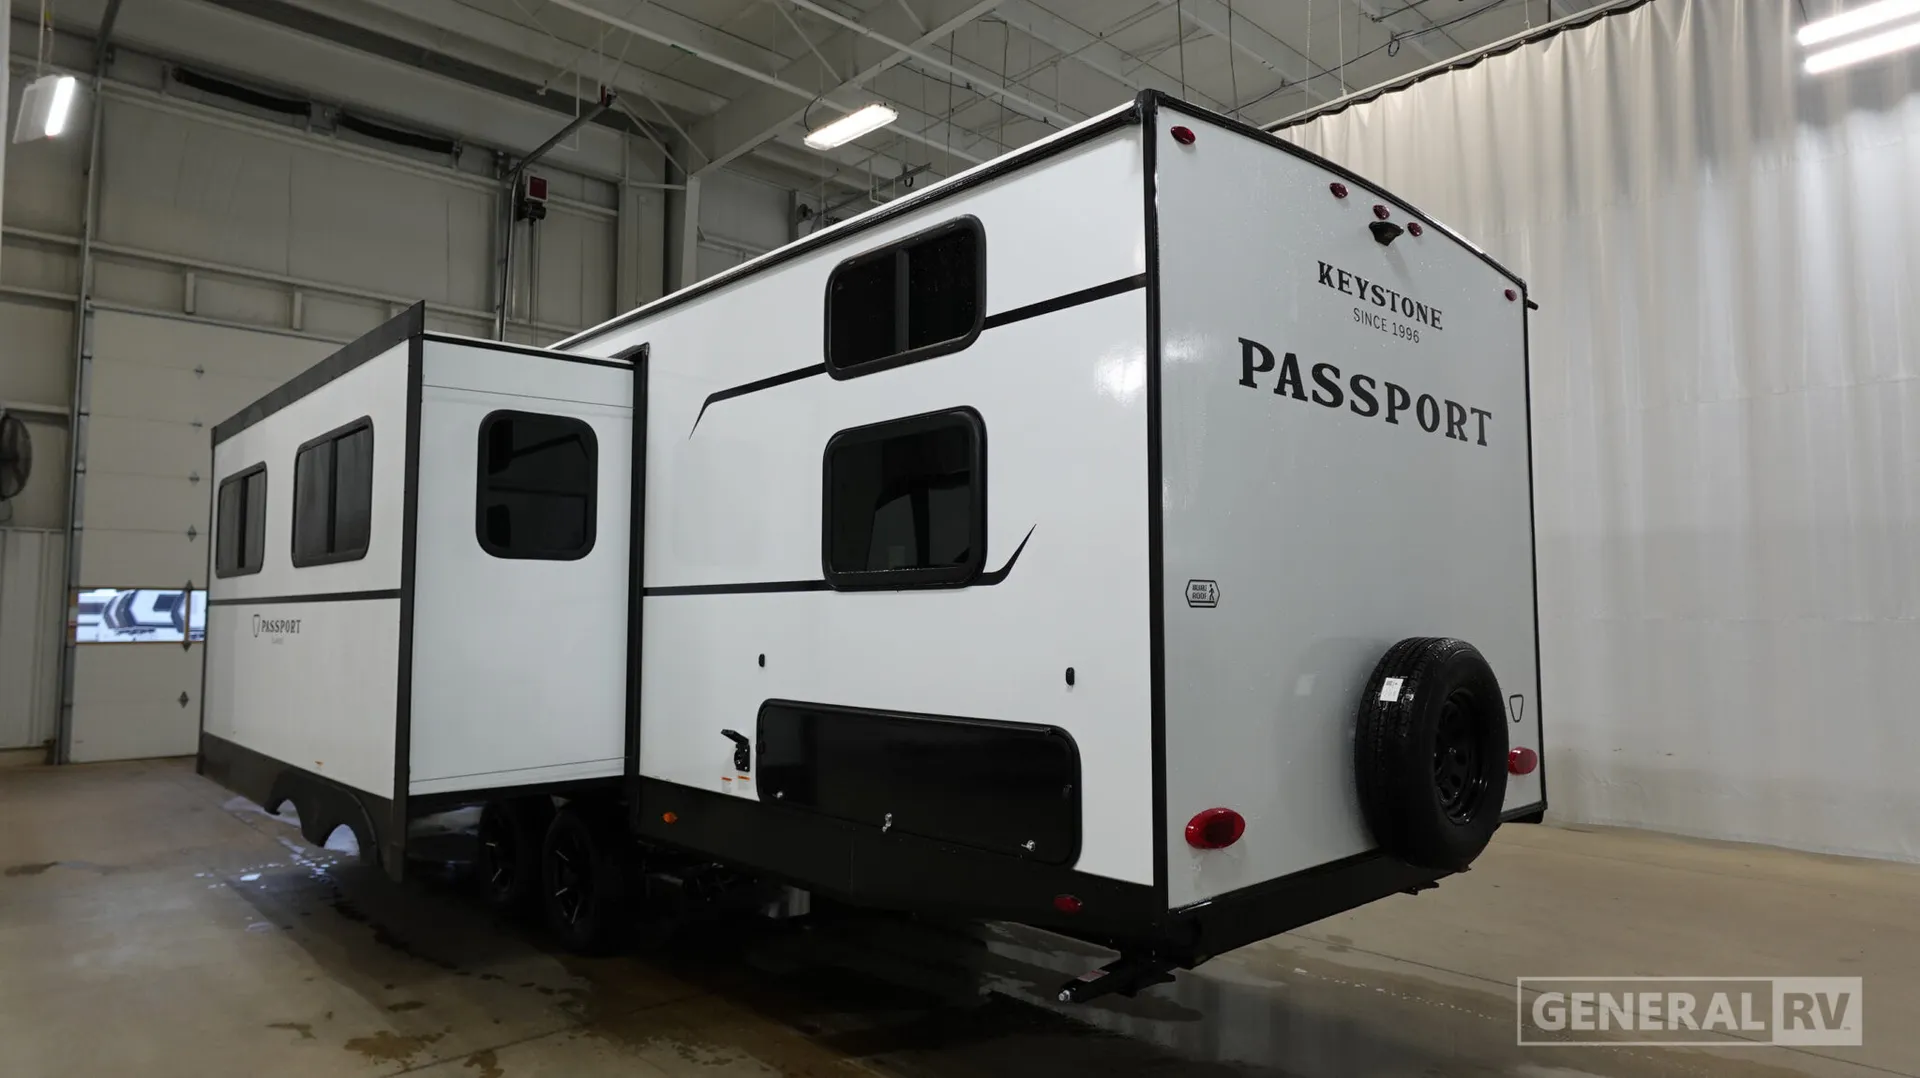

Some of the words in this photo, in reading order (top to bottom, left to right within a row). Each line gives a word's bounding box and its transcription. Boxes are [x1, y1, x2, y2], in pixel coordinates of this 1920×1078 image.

[1317, 260, 1443, 330] KEYSTONE
[1353, 307, 1388, 332] SINCE
[1392, 321, 1420, 343] 1996
[1238, 336, 1492, 447] PASSPORT
[261, 619, 301, 634] PASSPORT
